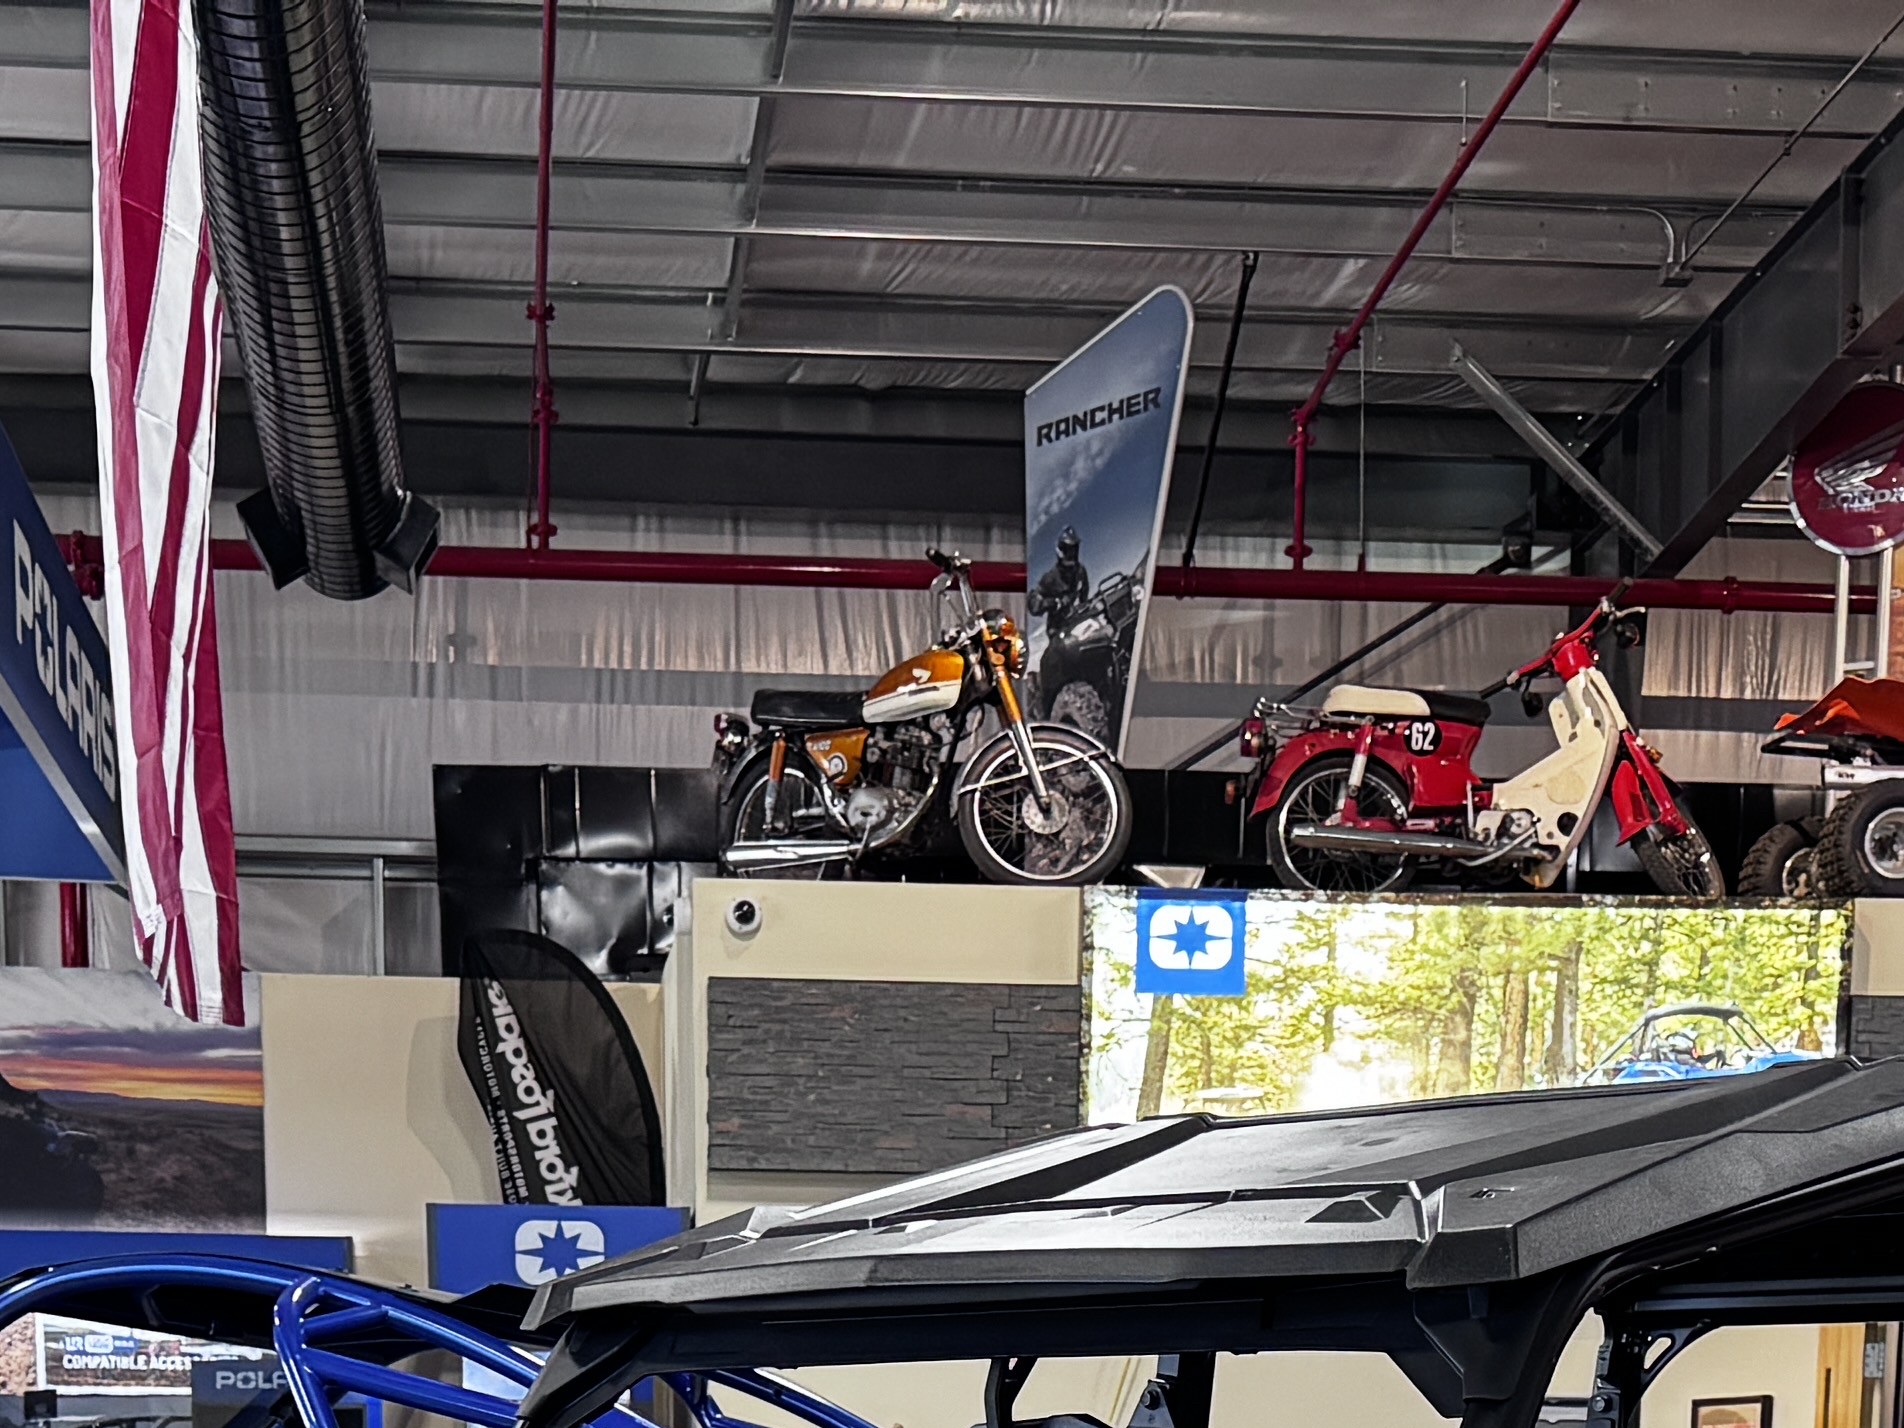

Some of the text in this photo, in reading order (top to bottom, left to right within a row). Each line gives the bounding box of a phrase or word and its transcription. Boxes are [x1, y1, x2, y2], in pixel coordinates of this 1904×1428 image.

[1035, 387, 1162, 447] RANCHER
[13, 518, 116, 802] POLARIS
[1410, 722, 1438, 752] 62
[62, 1354, 146, 1370] COMPATIBLE
